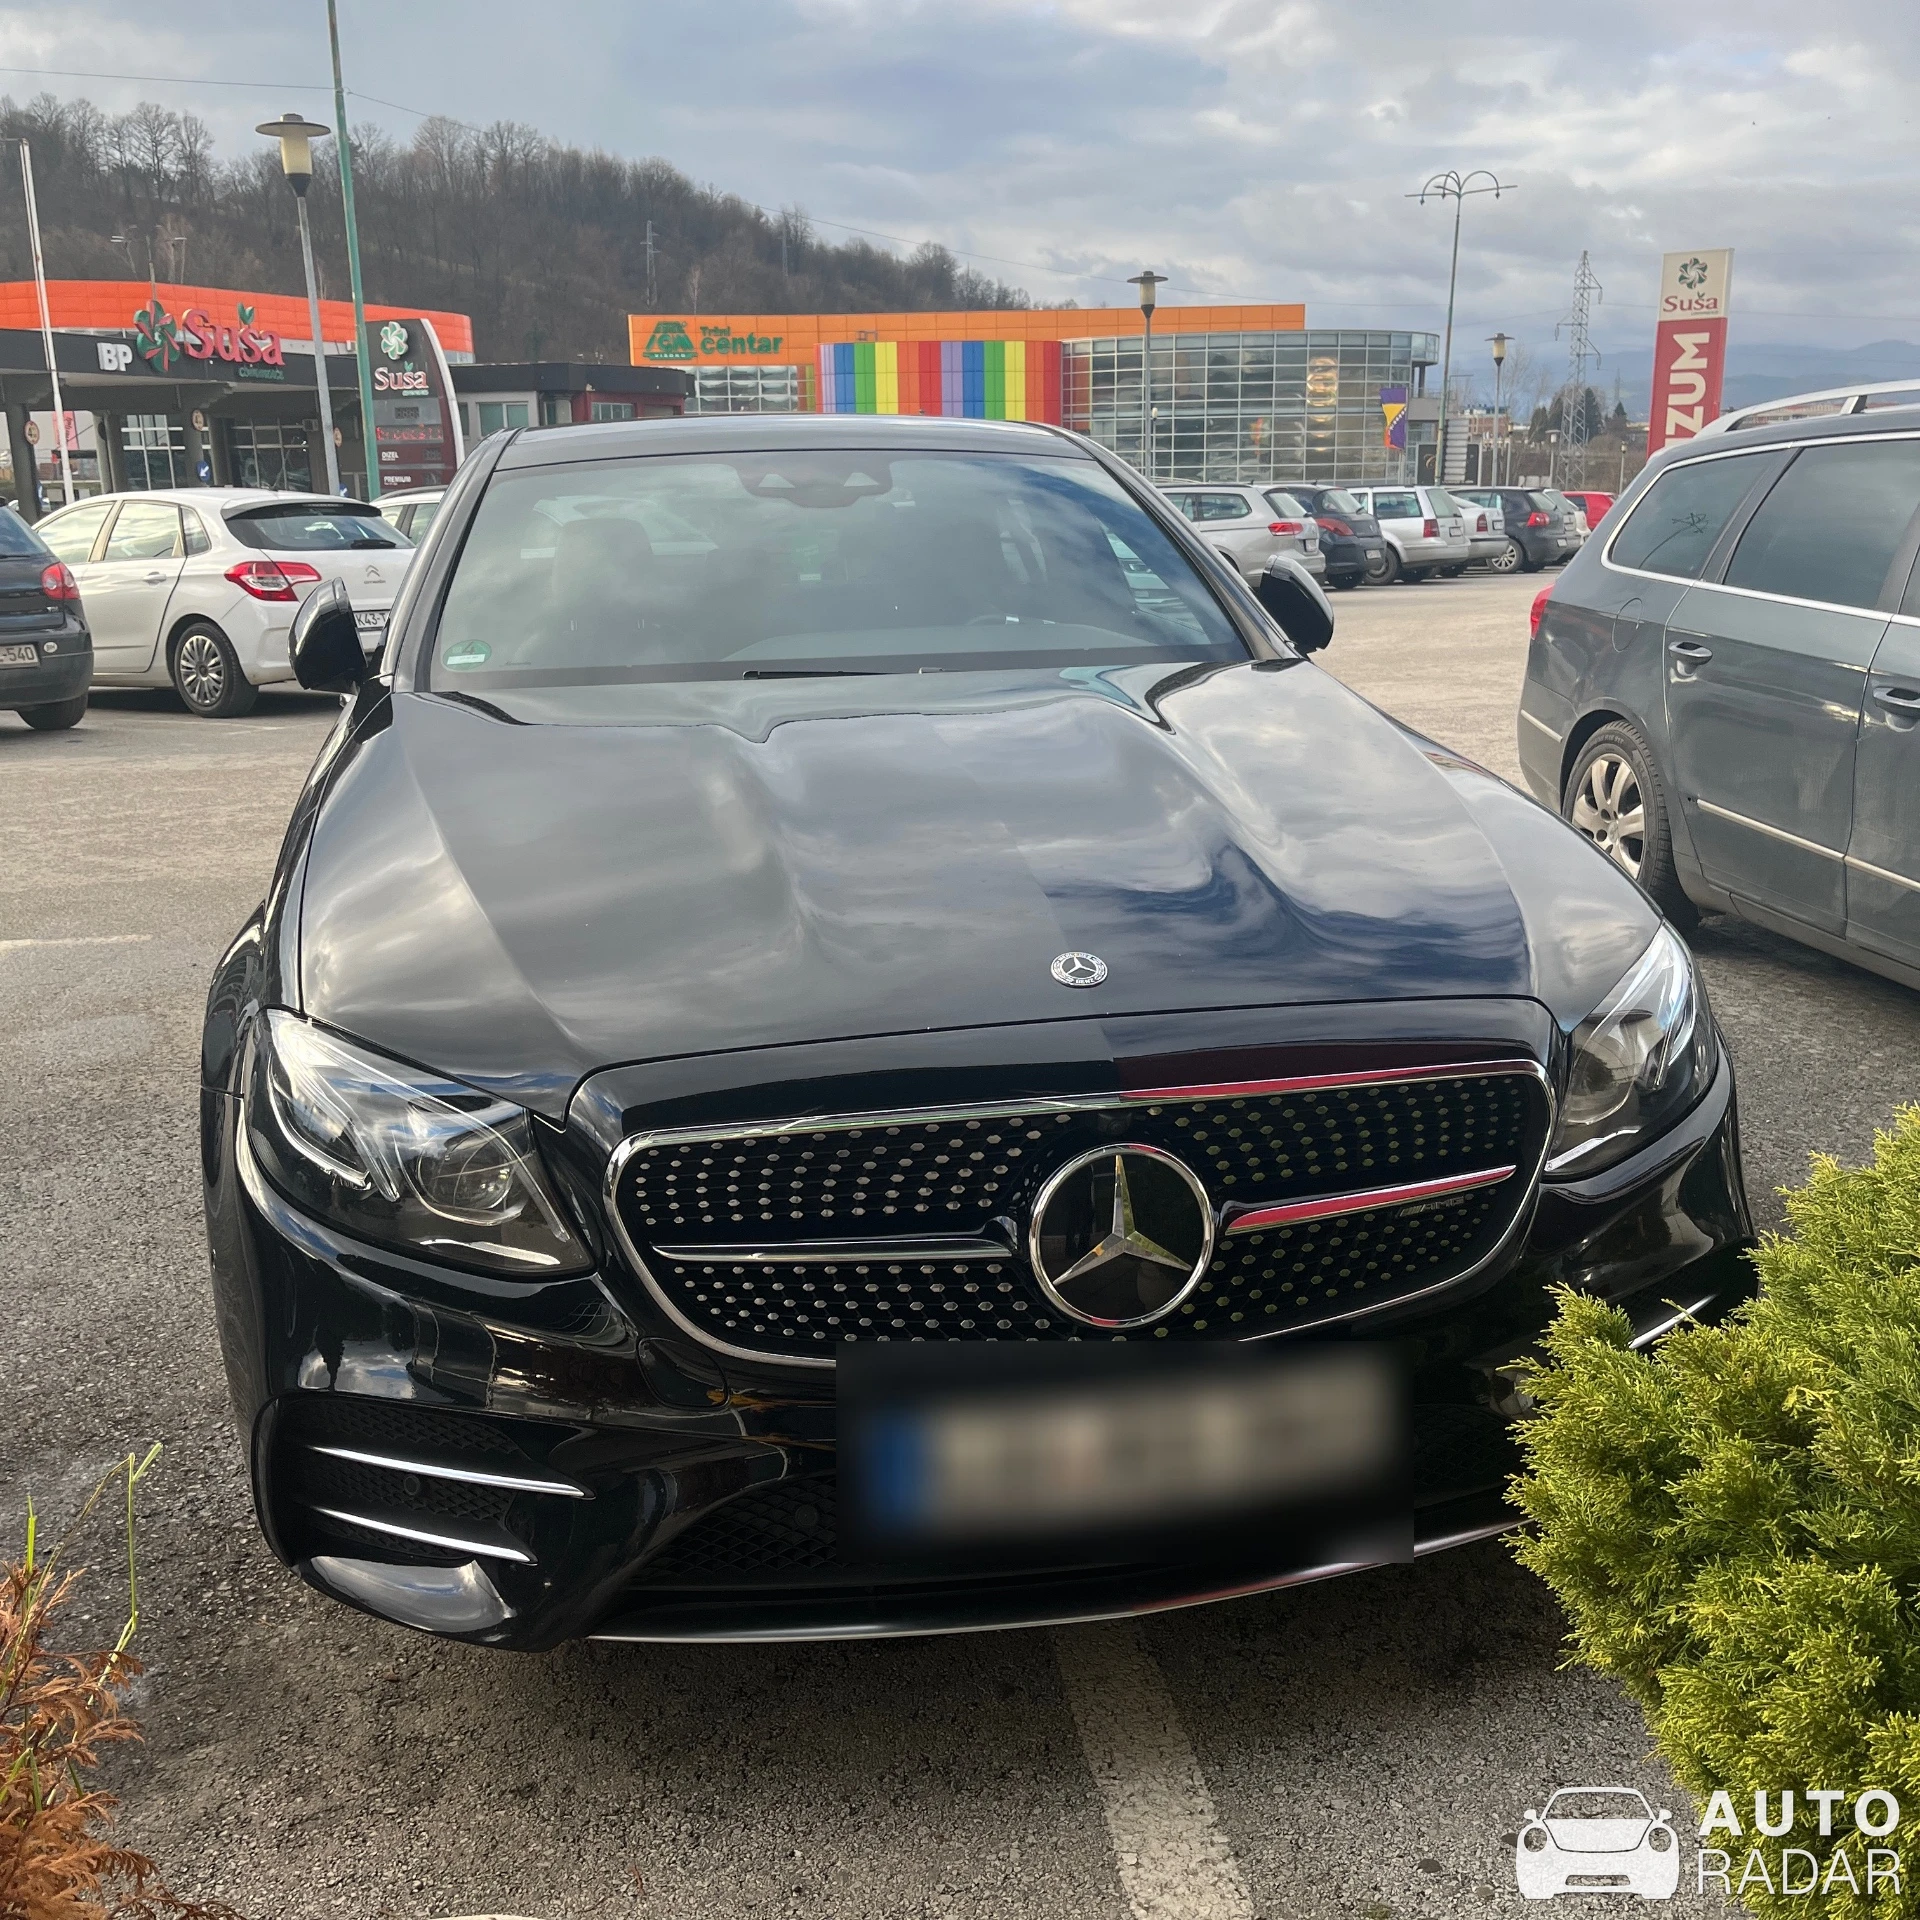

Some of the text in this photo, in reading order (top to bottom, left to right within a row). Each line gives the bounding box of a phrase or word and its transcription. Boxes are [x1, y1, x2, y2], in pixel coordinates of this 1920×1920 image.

[1662, 291, 1718, 312] Suša
[701, 332, 783, 354] centar
[97, 342, 133, 371] BP
[0, 646, 35, 662] -540
